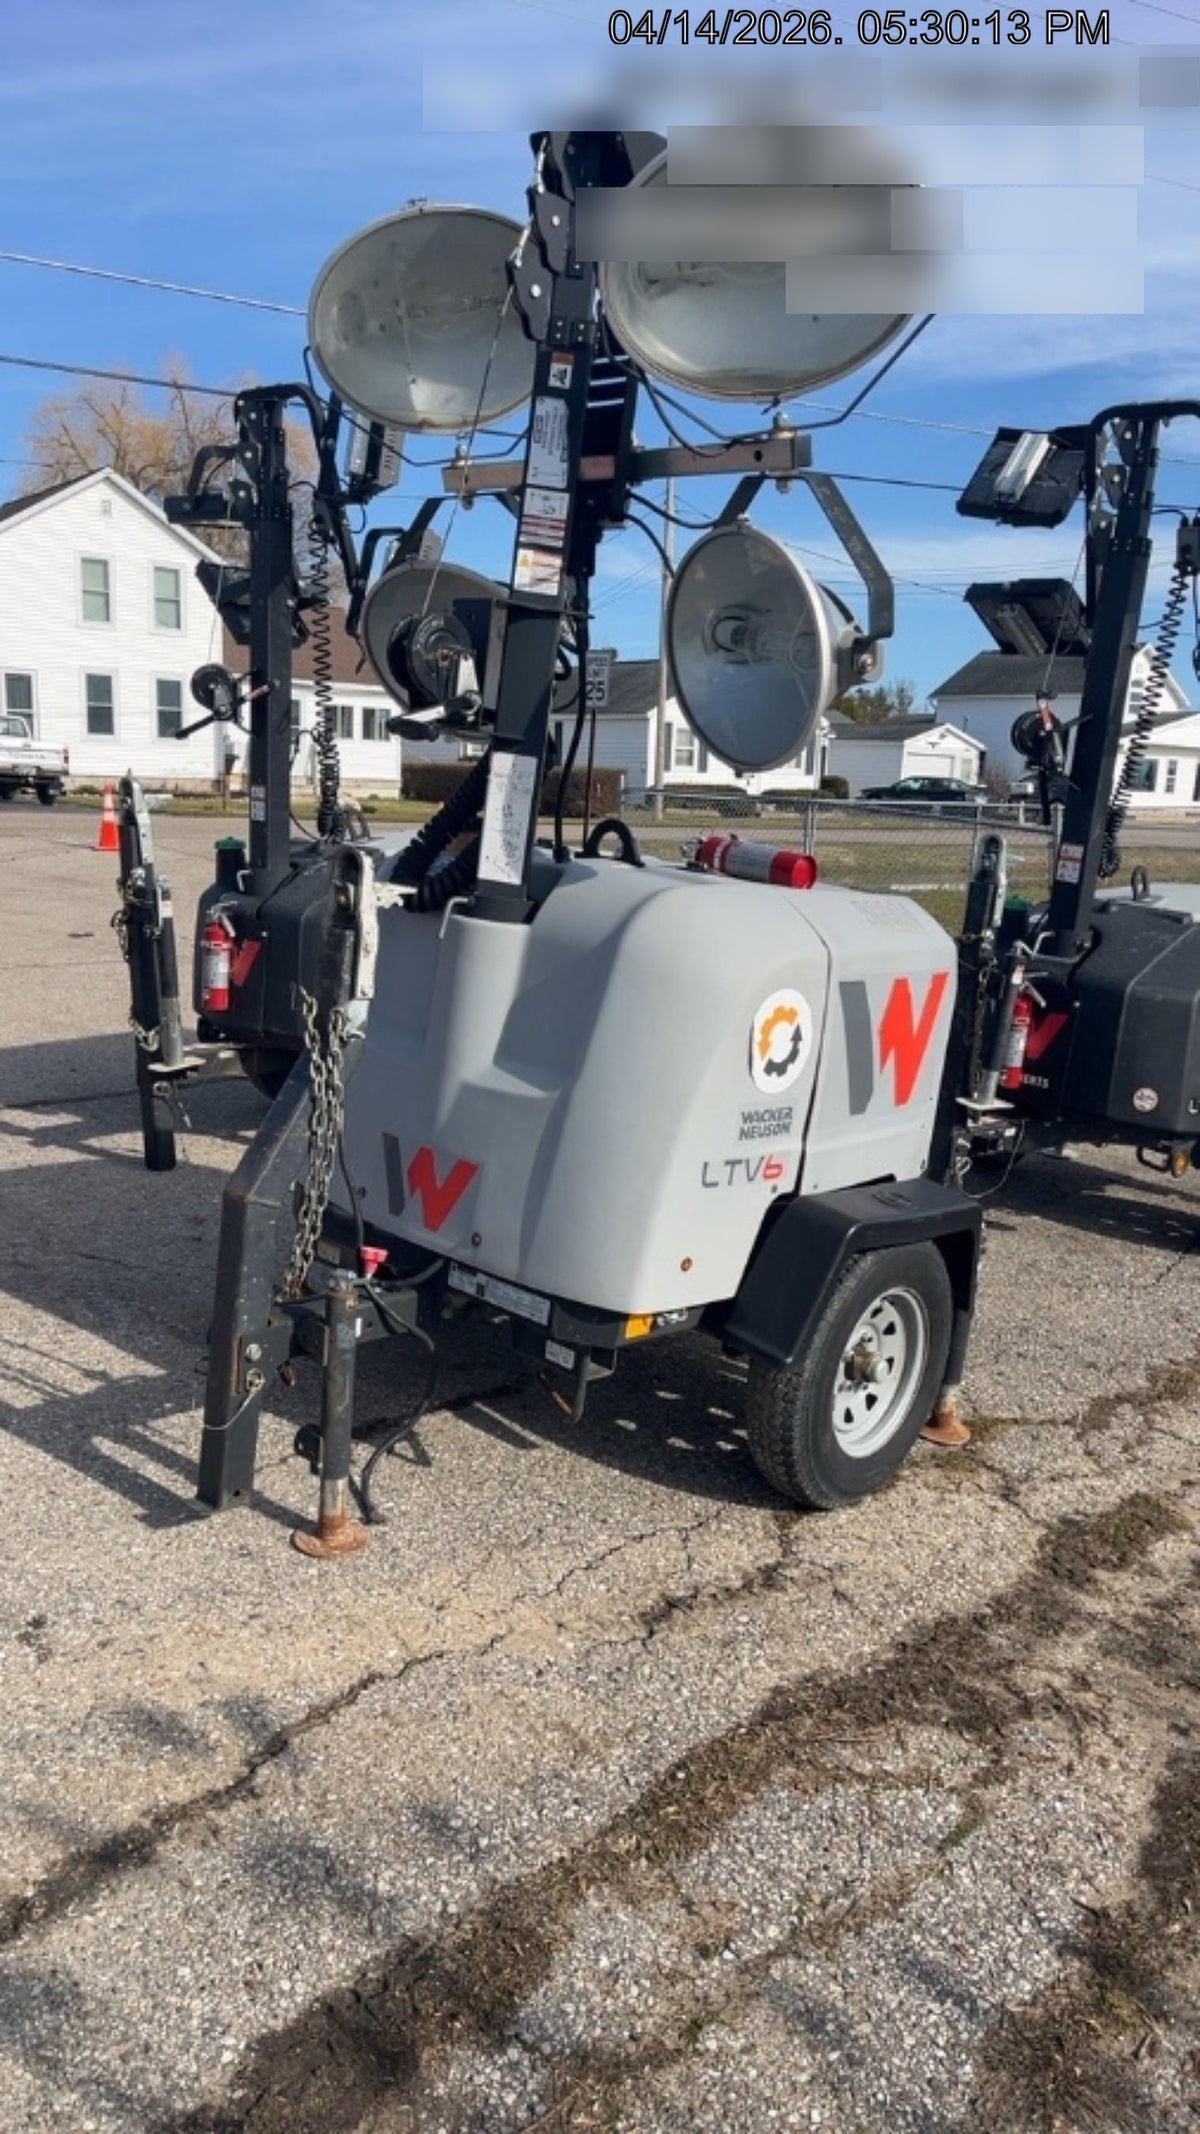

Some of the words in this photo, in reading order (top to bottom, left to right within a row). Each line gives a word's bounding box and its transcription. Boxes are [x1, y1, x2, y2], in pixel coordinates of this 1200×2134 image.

[585, 680, 605, 701] 25
[741, 1107, 792, 1125] WACKER
[739, 1122, 791, 1141] NEUSON
[702, 1154, 783, 1188] LTV6
